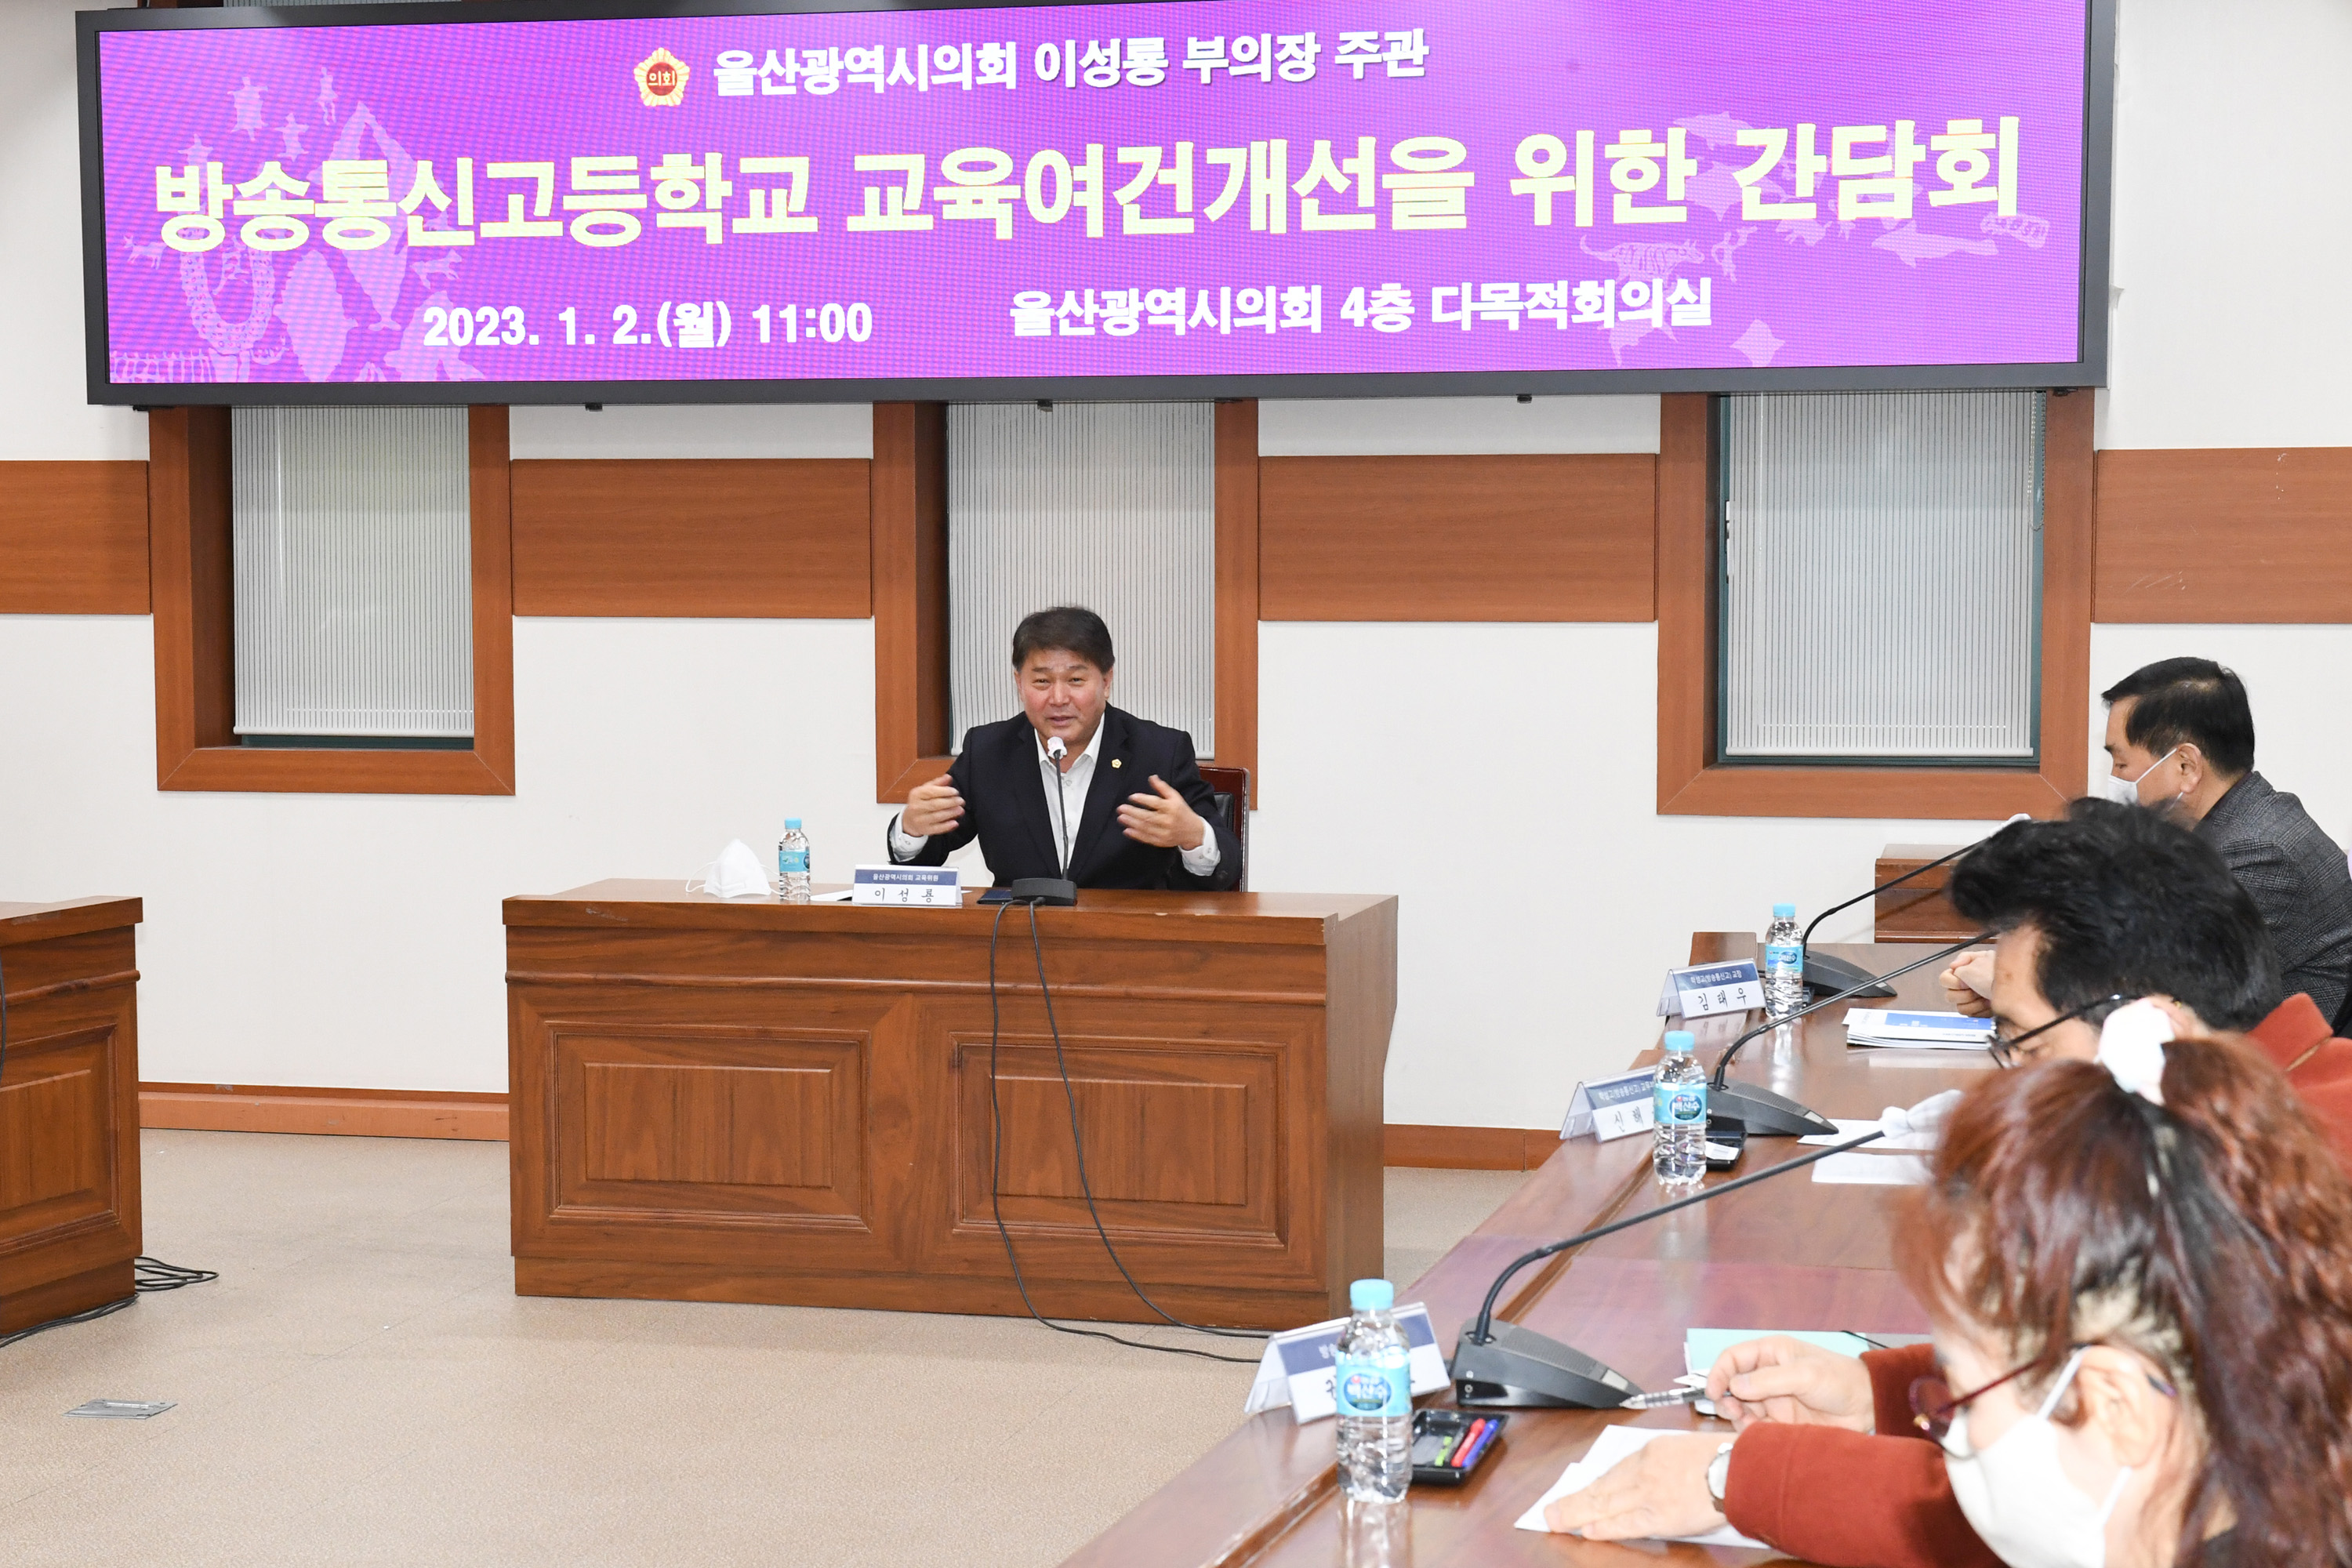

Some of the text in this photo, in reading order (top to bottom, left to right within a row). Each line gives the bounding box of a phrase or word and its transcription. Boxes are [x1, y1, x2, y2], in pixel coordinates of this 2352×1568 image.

[648, 71, 675, 86] 의회
[713, 27, 1429, 96] 울산광역시의회 이성룡 부의장 주관
[156, 116, 2020, 253] 방송통신고등학교 교육여건개선을 위한 간담회
[423, 300, 873, 348] 2023. 1. 2.(월) 11:00
[1010, 277, 1711, 336] 울산광역시의회 4층 다목적회의실
